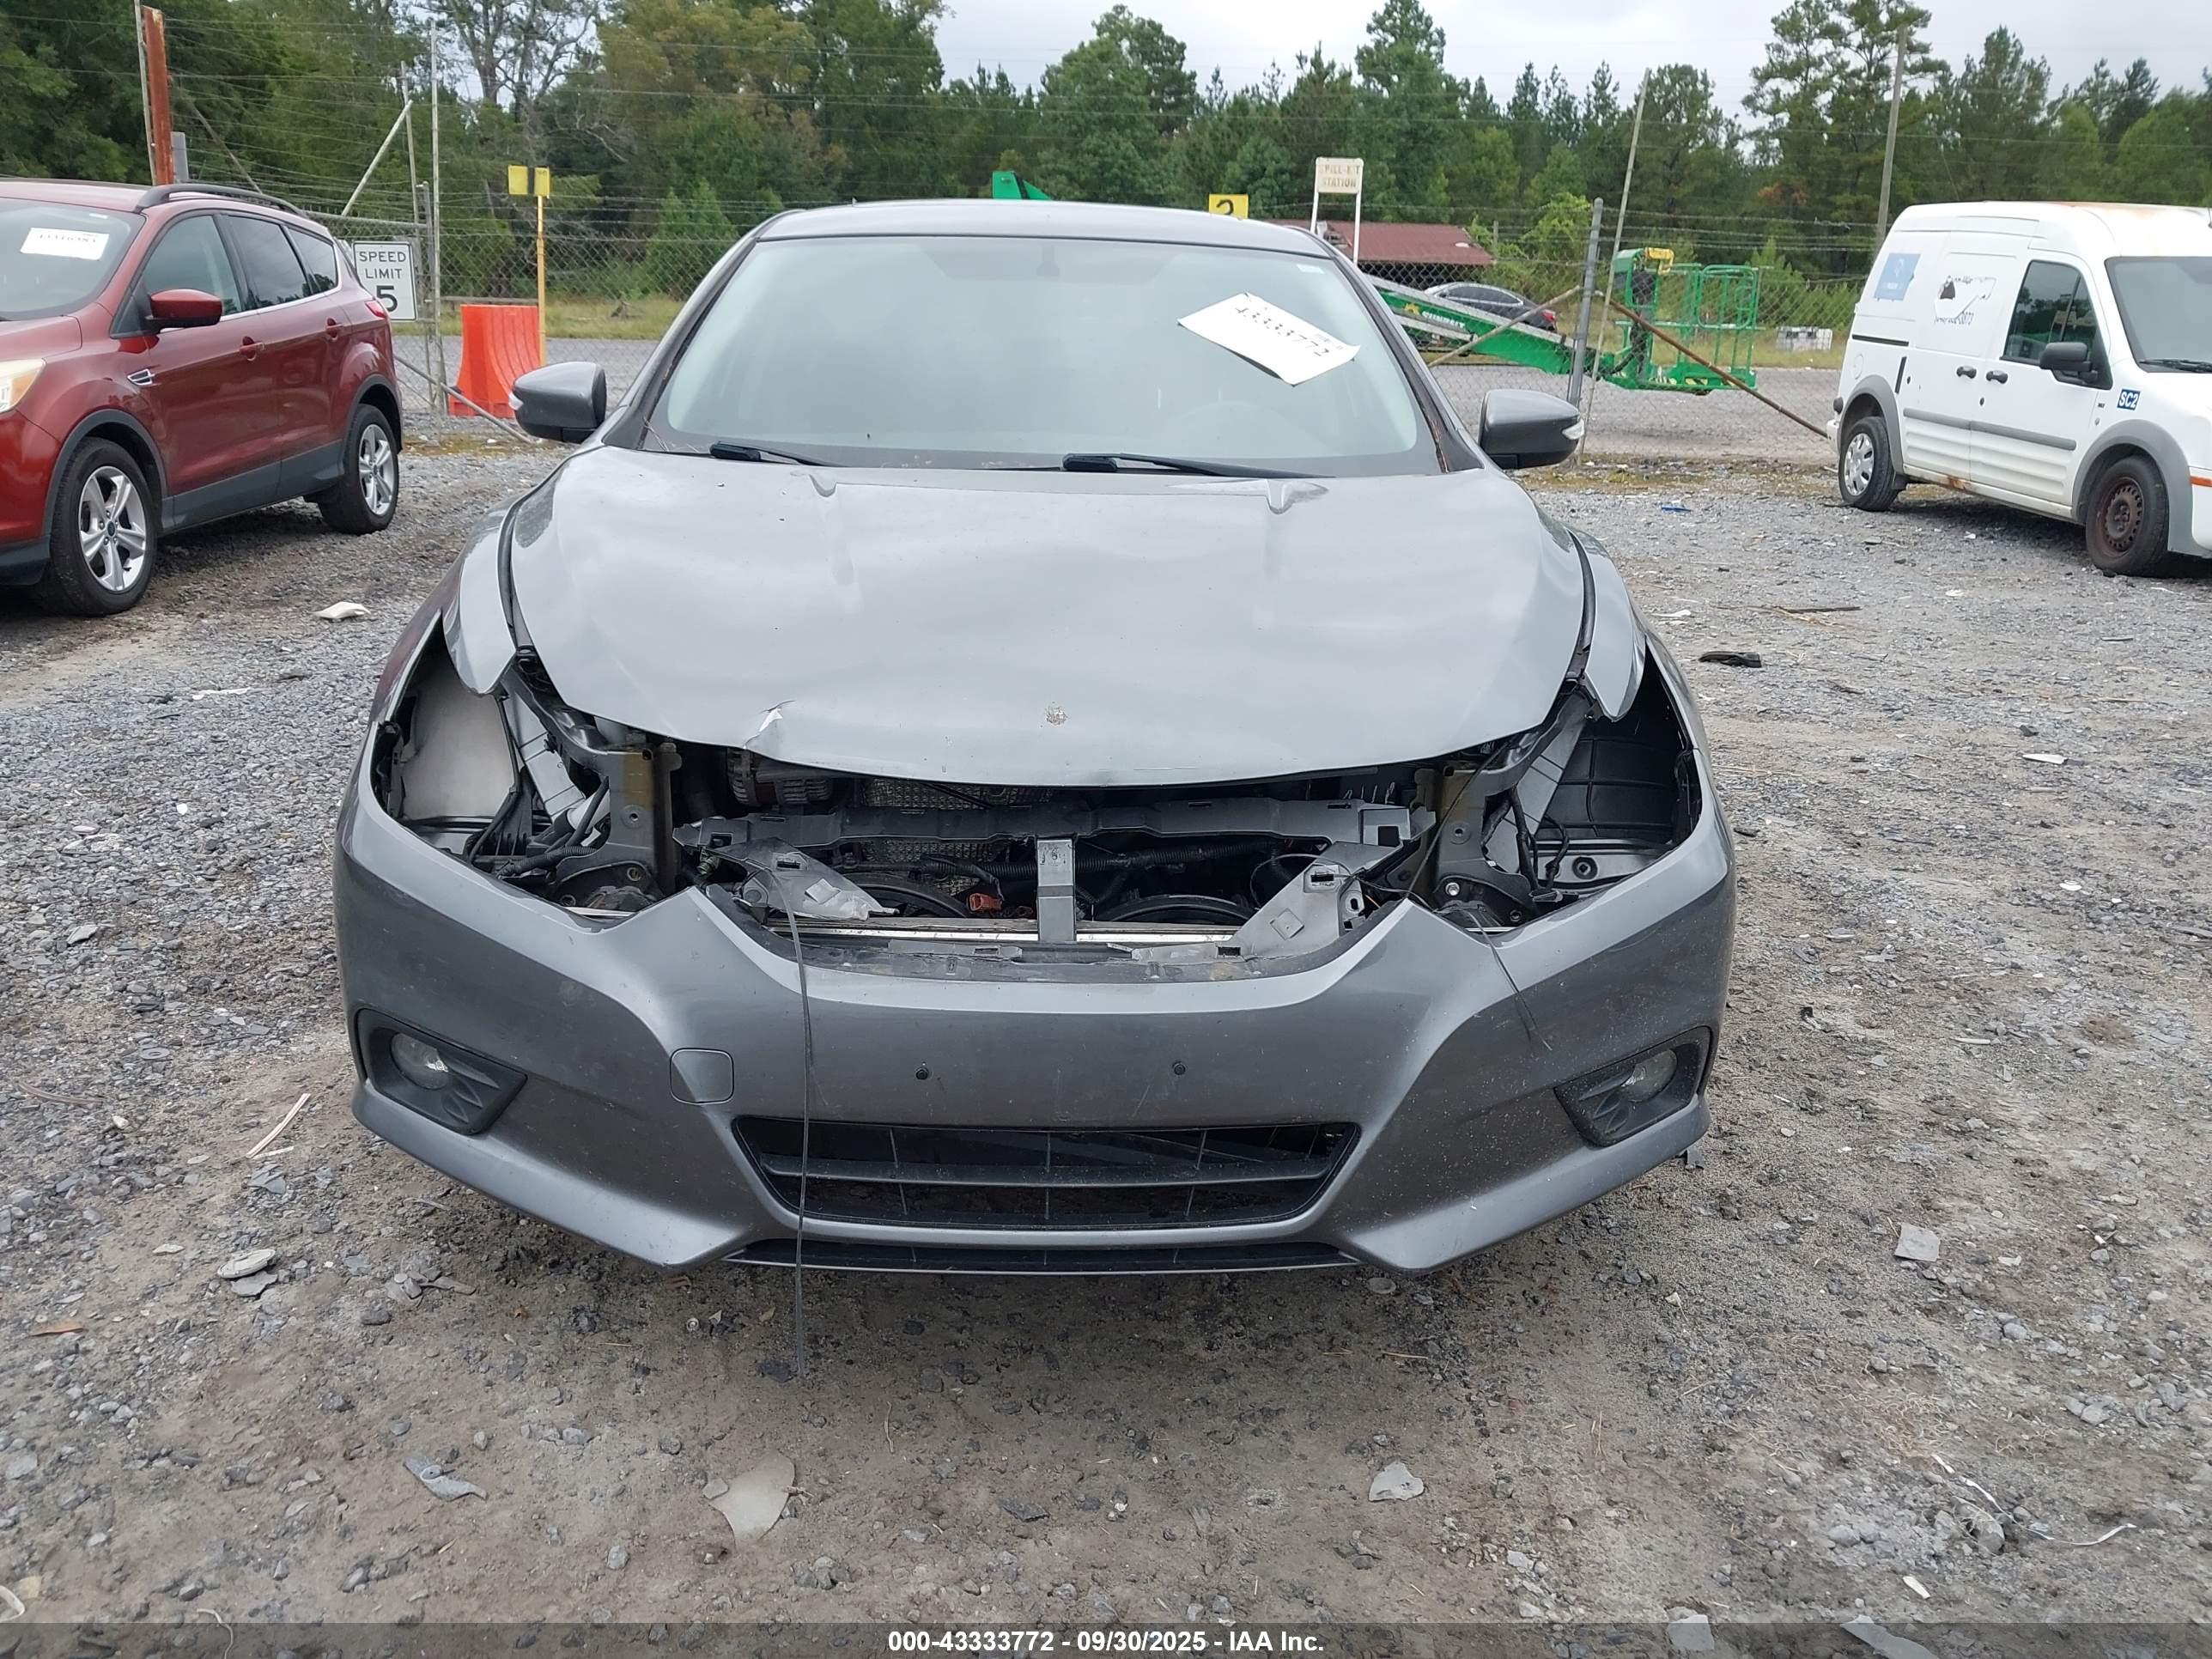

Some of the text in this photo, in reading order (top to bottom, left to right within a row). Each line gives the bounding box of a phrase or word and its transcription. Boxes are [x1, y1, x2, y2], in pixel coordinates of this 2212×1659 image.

[359, 251, 407, 263] SPEED
[365, 268, 403, 279] LIMIT
[376, 284, 398, 313] 5
[1235, 307, 1330, 357] 43333772
[2118, 391, 2138, 409] SC2
